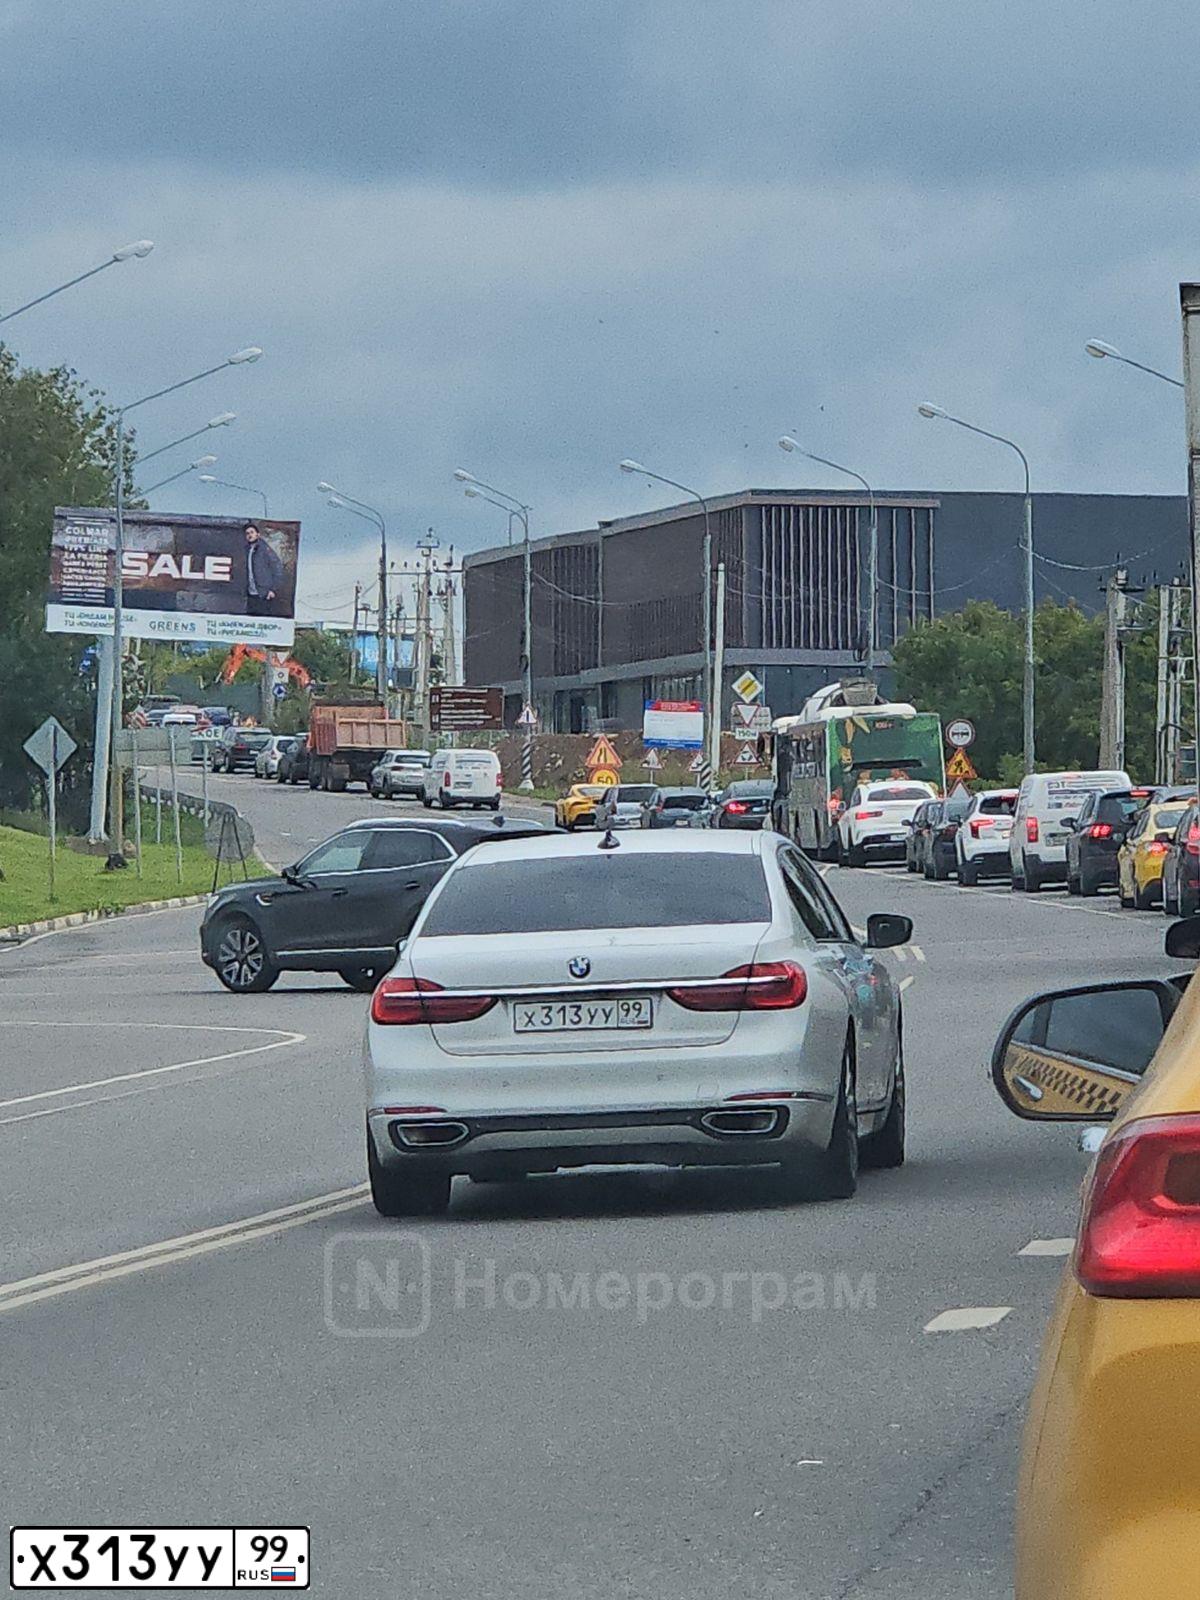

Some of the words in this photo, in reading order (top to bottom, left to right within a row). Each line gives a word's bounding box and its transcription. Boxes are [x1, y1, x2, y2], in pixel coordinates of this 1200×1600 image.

[121, 552, 232, 581] SALE
[149, 620, 196, 632] GREENS
[620, 1001, 643, 1018] 99
